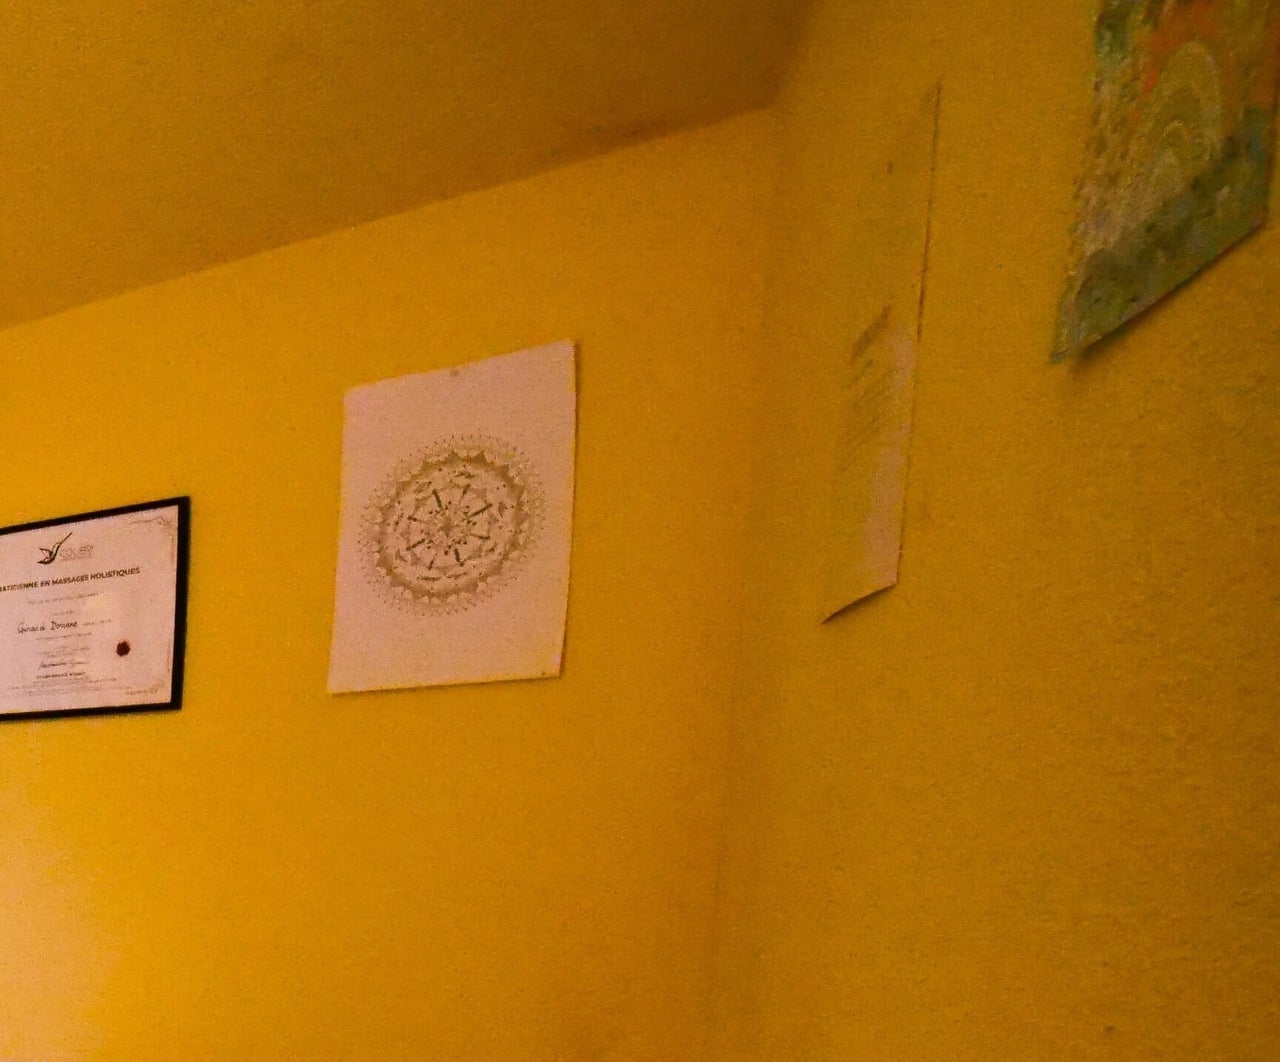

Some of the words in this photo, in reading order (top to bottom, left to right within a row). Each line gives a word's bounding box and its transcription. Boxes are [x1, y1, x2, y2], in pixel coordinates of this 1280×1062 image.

[40, 579, 51, 587] EN
[51, 574, 89, 586] MASSAGES
[90, 566, 141, 579] HOLISTIQUES
